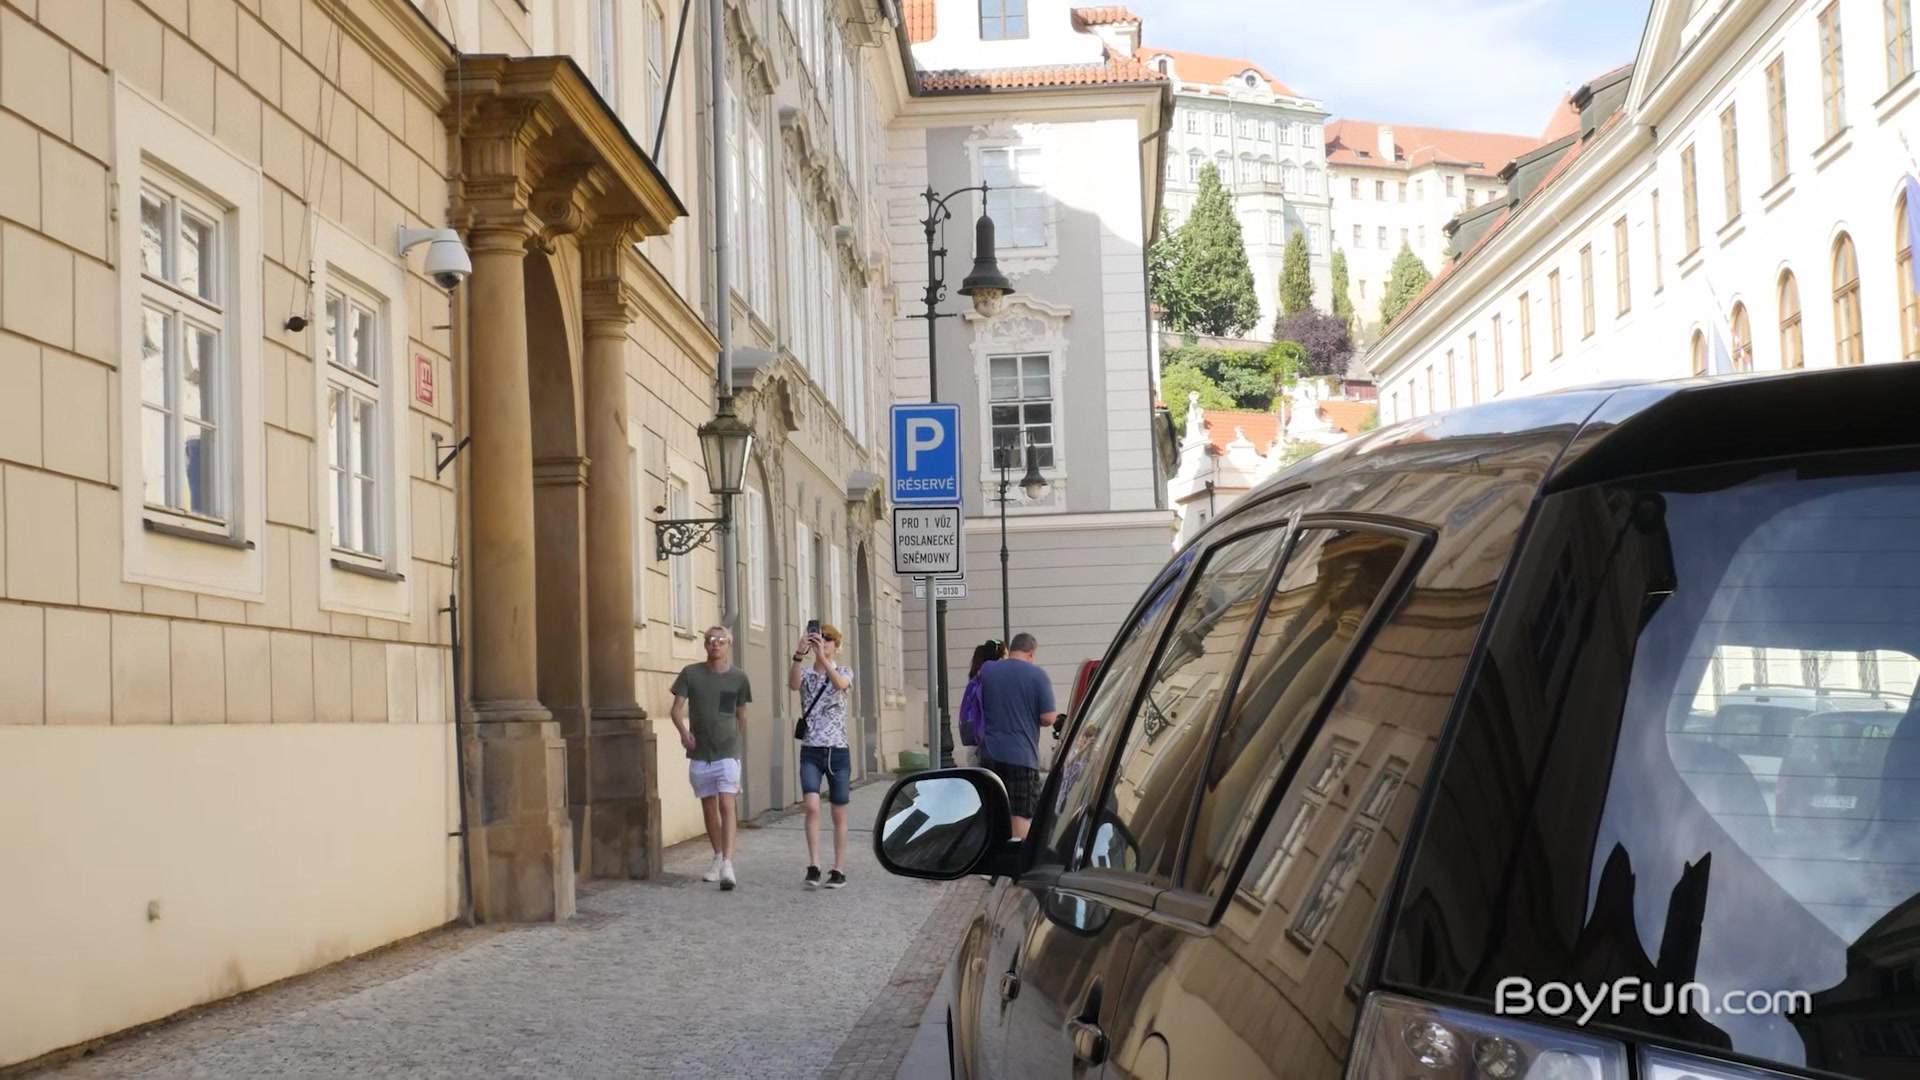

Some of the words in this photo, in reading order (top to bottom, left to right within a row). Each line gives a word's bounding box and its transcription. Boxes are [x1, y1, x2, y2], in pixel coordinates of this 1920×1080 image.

[906, 417, 945, 472] P
[897, 476, 955, 491] RÉSERVÉ
[901, 517, 919, 529] PRO
[925, 517, 929, 528] 1
[934, 514, 952, 528] VŮZ
[898, 532, 955, 546] POSLANECKÉ
[902, 551, 951, 564] SNĚMOVNY
[935, 586, 959, 595] 1-0130
